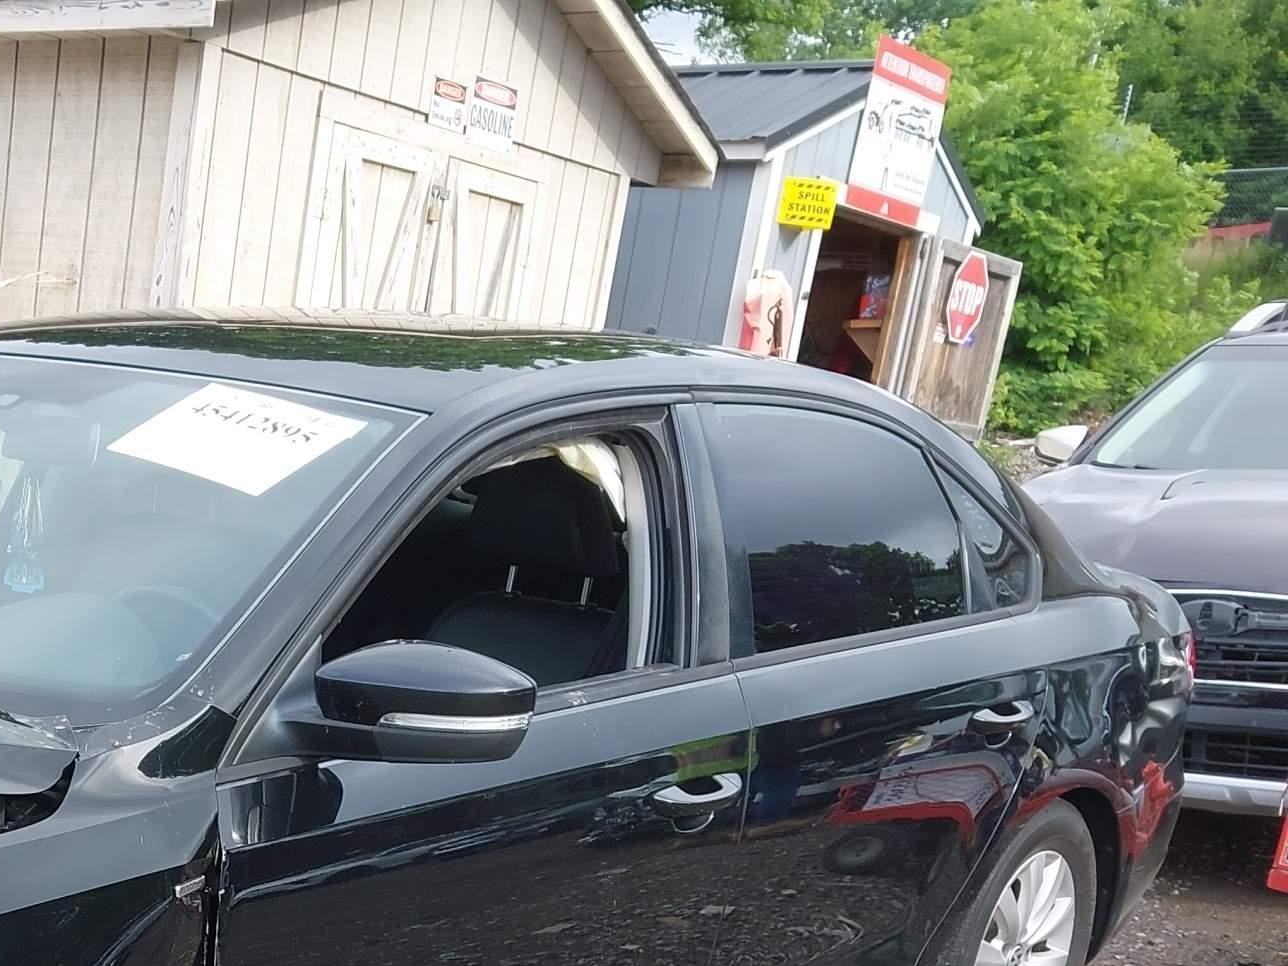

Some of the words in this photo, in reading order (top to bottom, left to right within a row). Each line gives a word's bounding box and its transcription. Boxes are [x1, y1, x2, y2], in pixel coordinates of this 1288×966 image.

[471, 104, 514, 138] GASOLINE
[798, 191, 825, 202] SPILL
[788, 202, 831, 216] STATION
[951, 278, 985, 316] STOP
